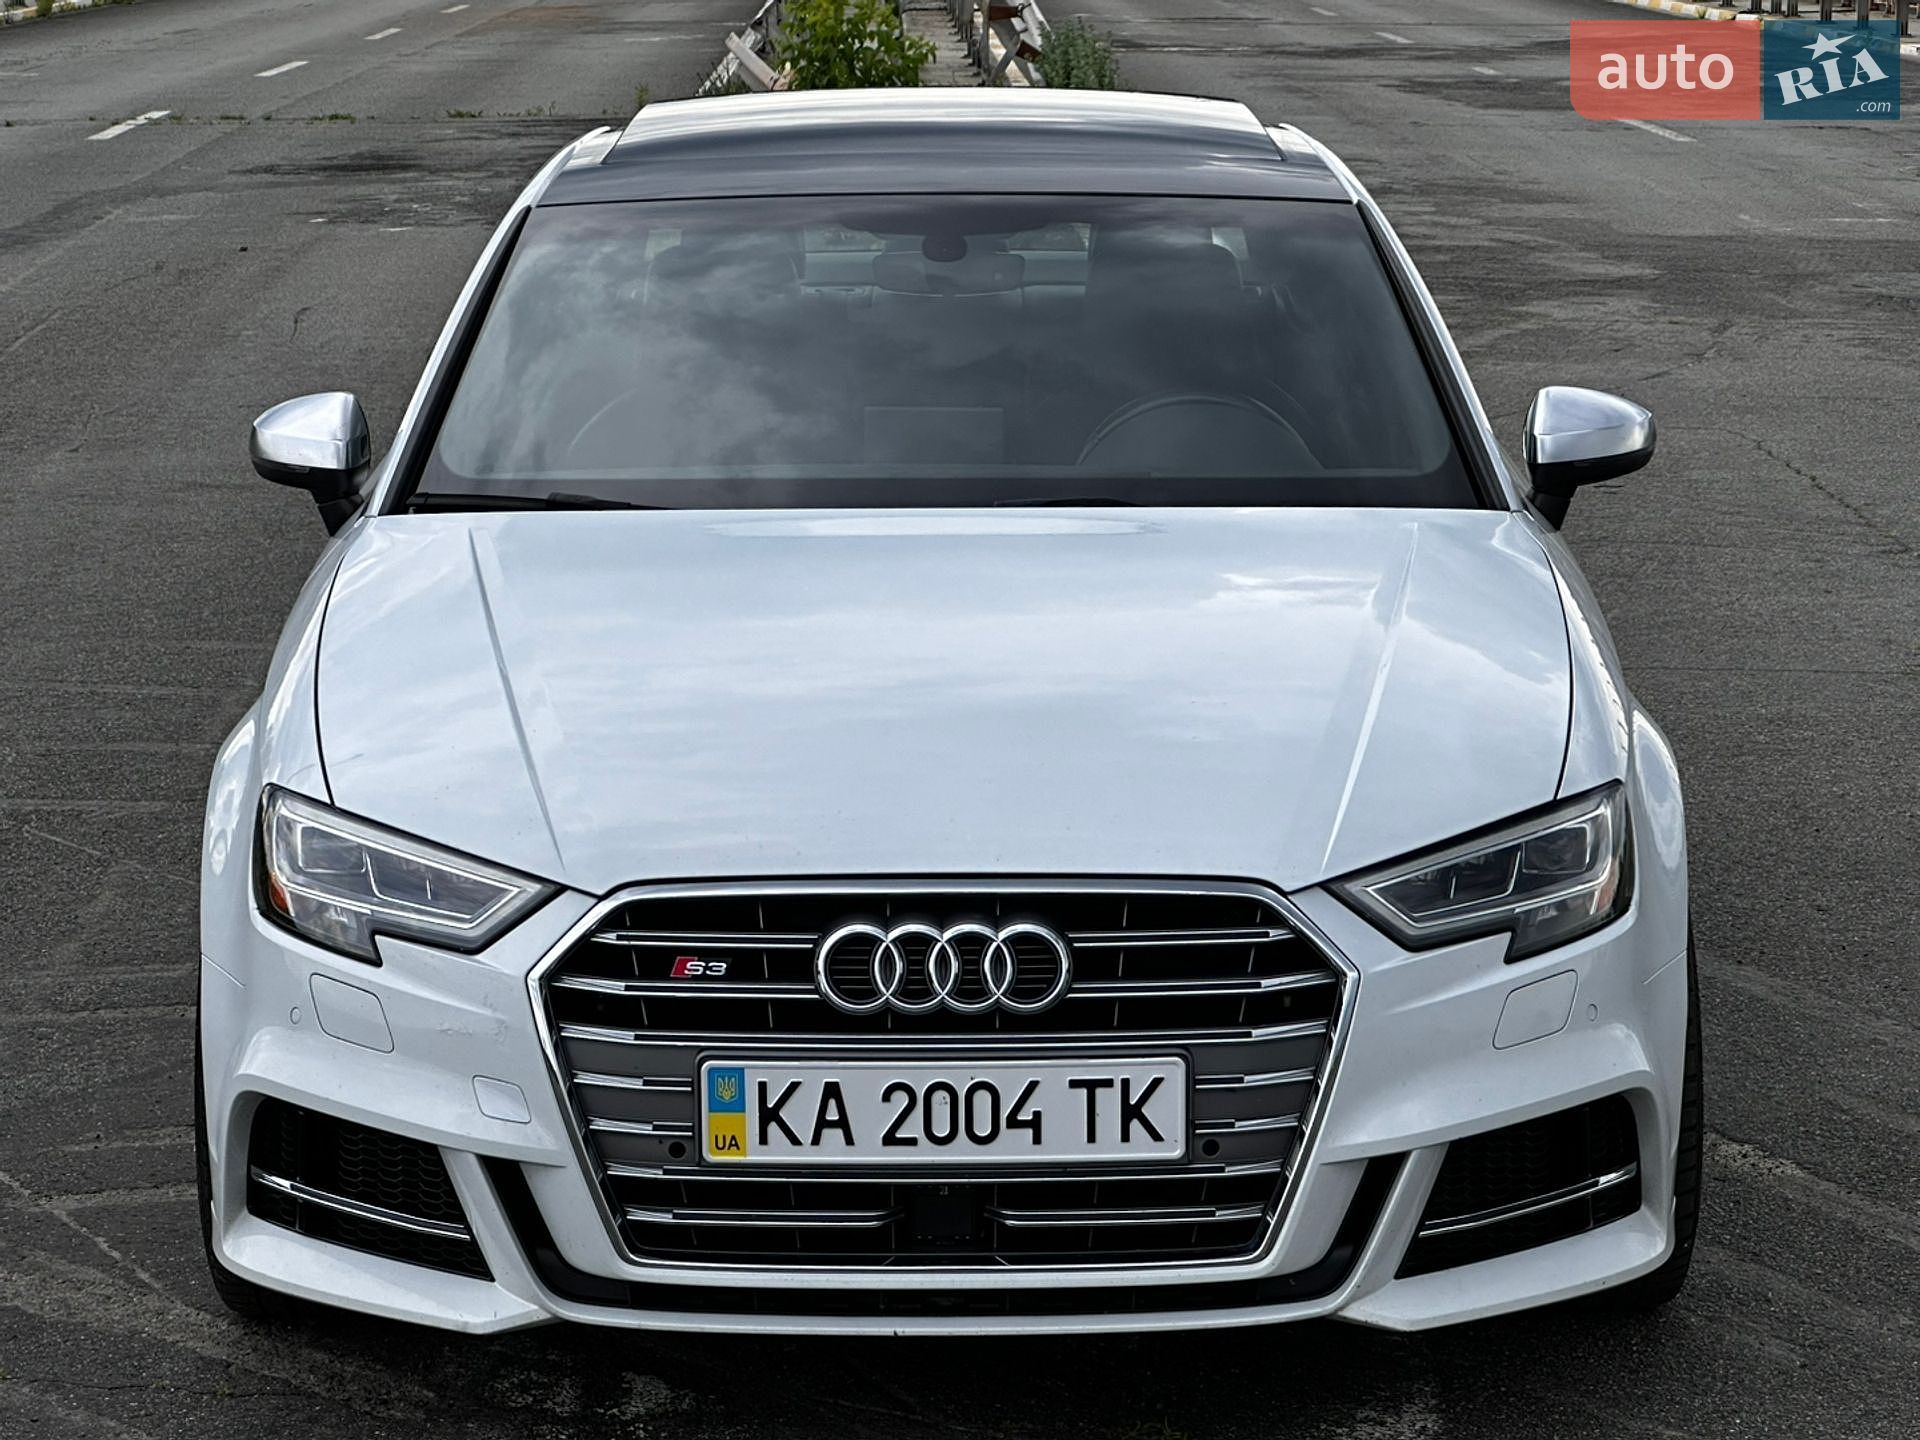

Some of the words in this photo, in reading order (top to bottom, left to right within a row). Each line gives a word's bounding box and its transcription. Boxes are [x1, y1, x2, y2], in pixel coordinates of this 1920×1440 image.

[684, 961, 727, 976] S3
[757, 1079, 855, 1146] KA
[881, 1079, 1042, 1146] 2004
[1068, 1077, 1165, 1143] TK
[714, 1135, 741, 1151] UA
